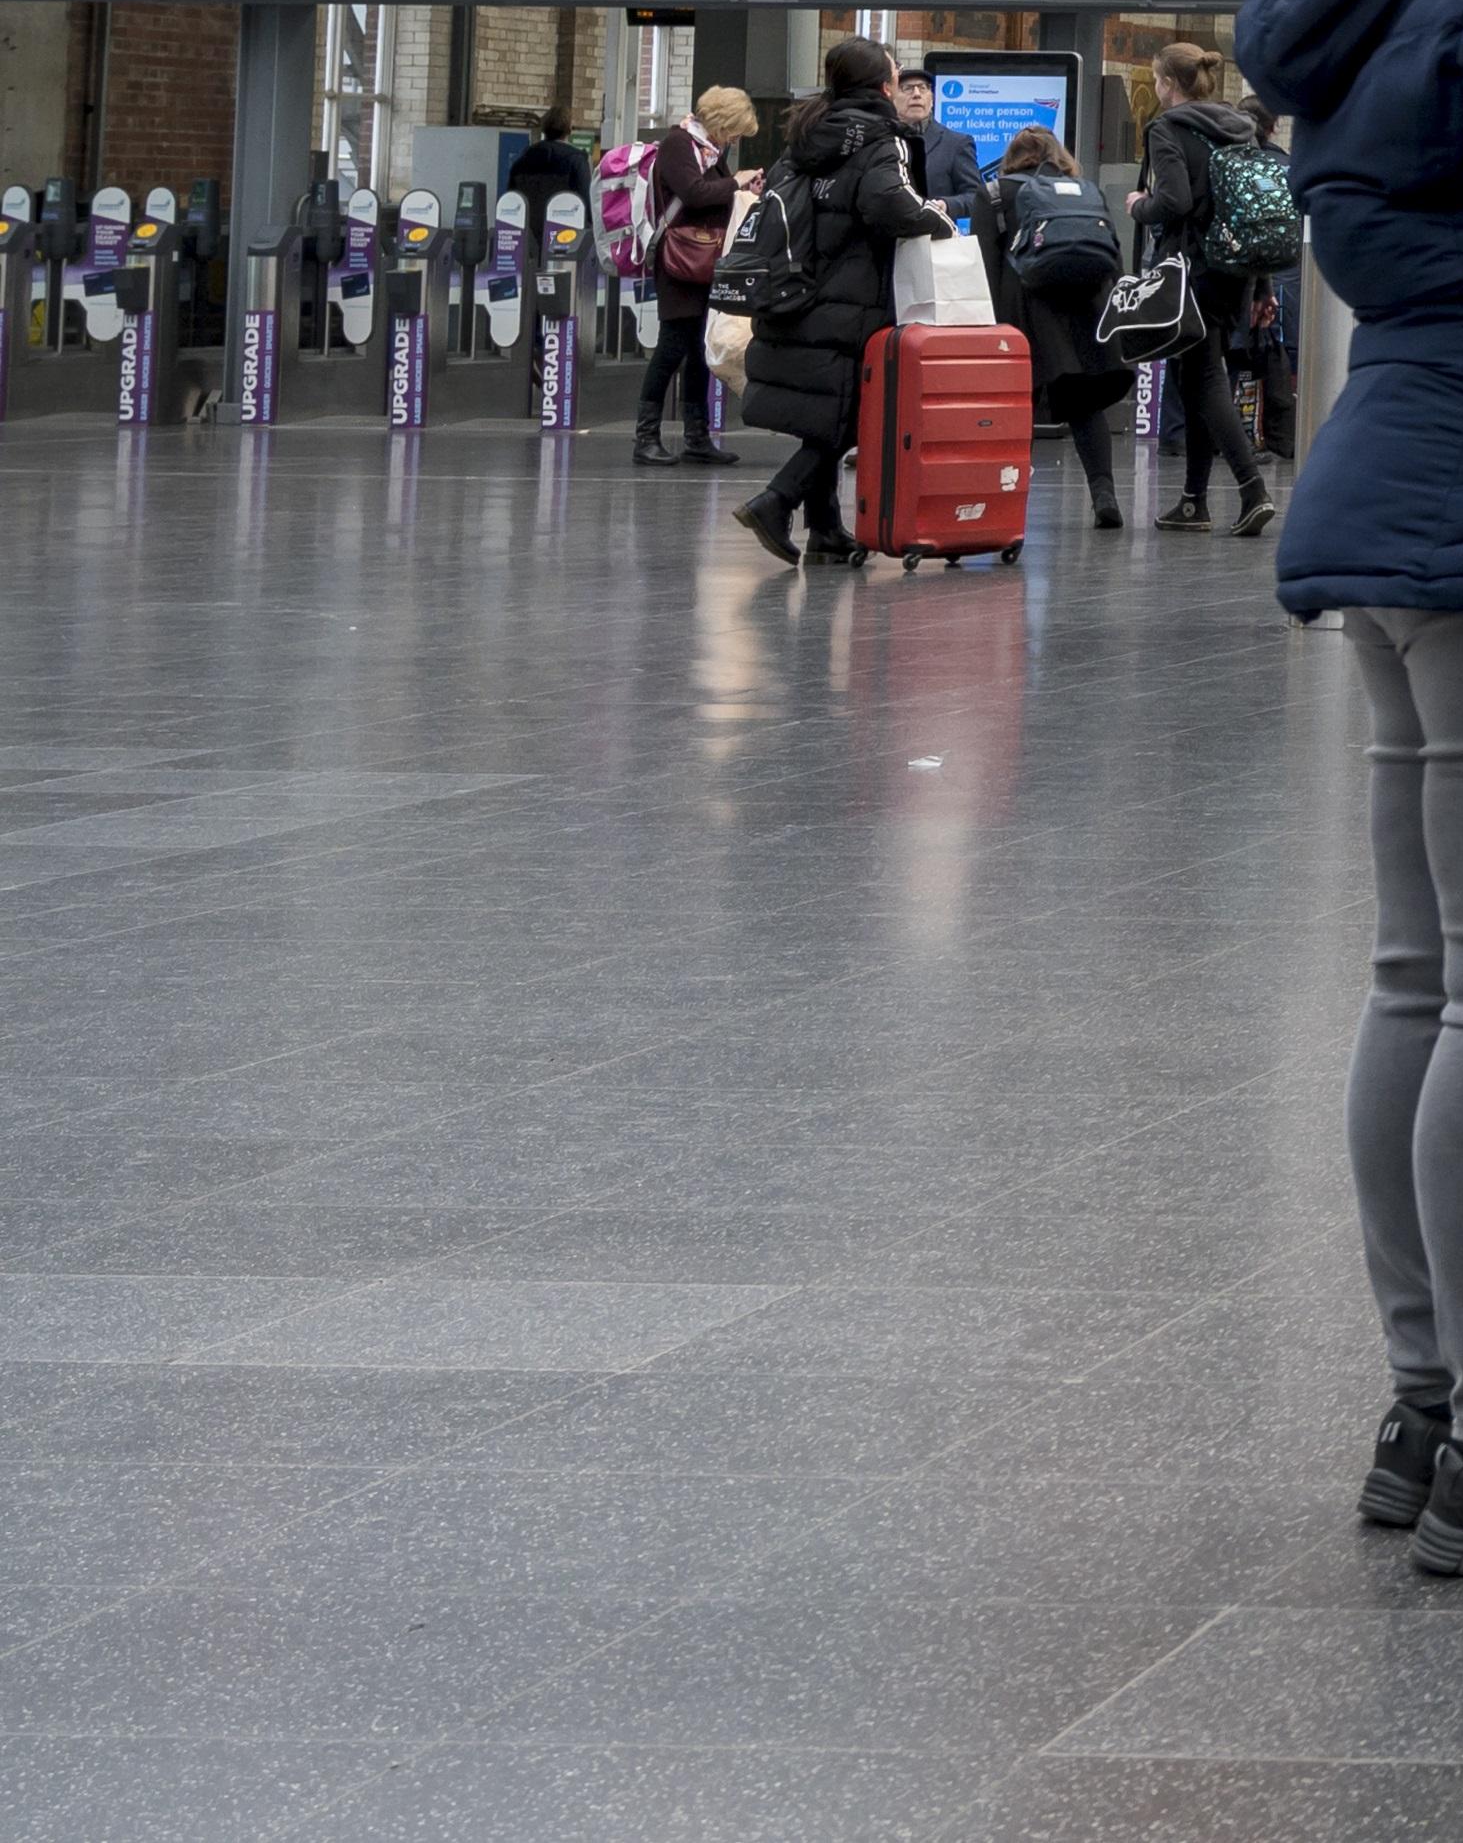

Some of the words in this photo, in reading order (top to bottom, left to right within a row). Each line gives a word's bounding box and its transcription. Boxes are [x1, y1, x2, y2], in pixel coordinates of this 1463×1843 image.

[947, 106, 974, 116] Only
[974, 108, 994, 116] one
[996, 108, 1033, 118] person
[966, 120, 995, 128] ticket
[119, 315, 138, 420] UPGRADE
[242, 314, 260, 420] UPGRADE
[392, 318, 410, 425] UPGRADE
[542, 319, 560, 426] UPGRADE
